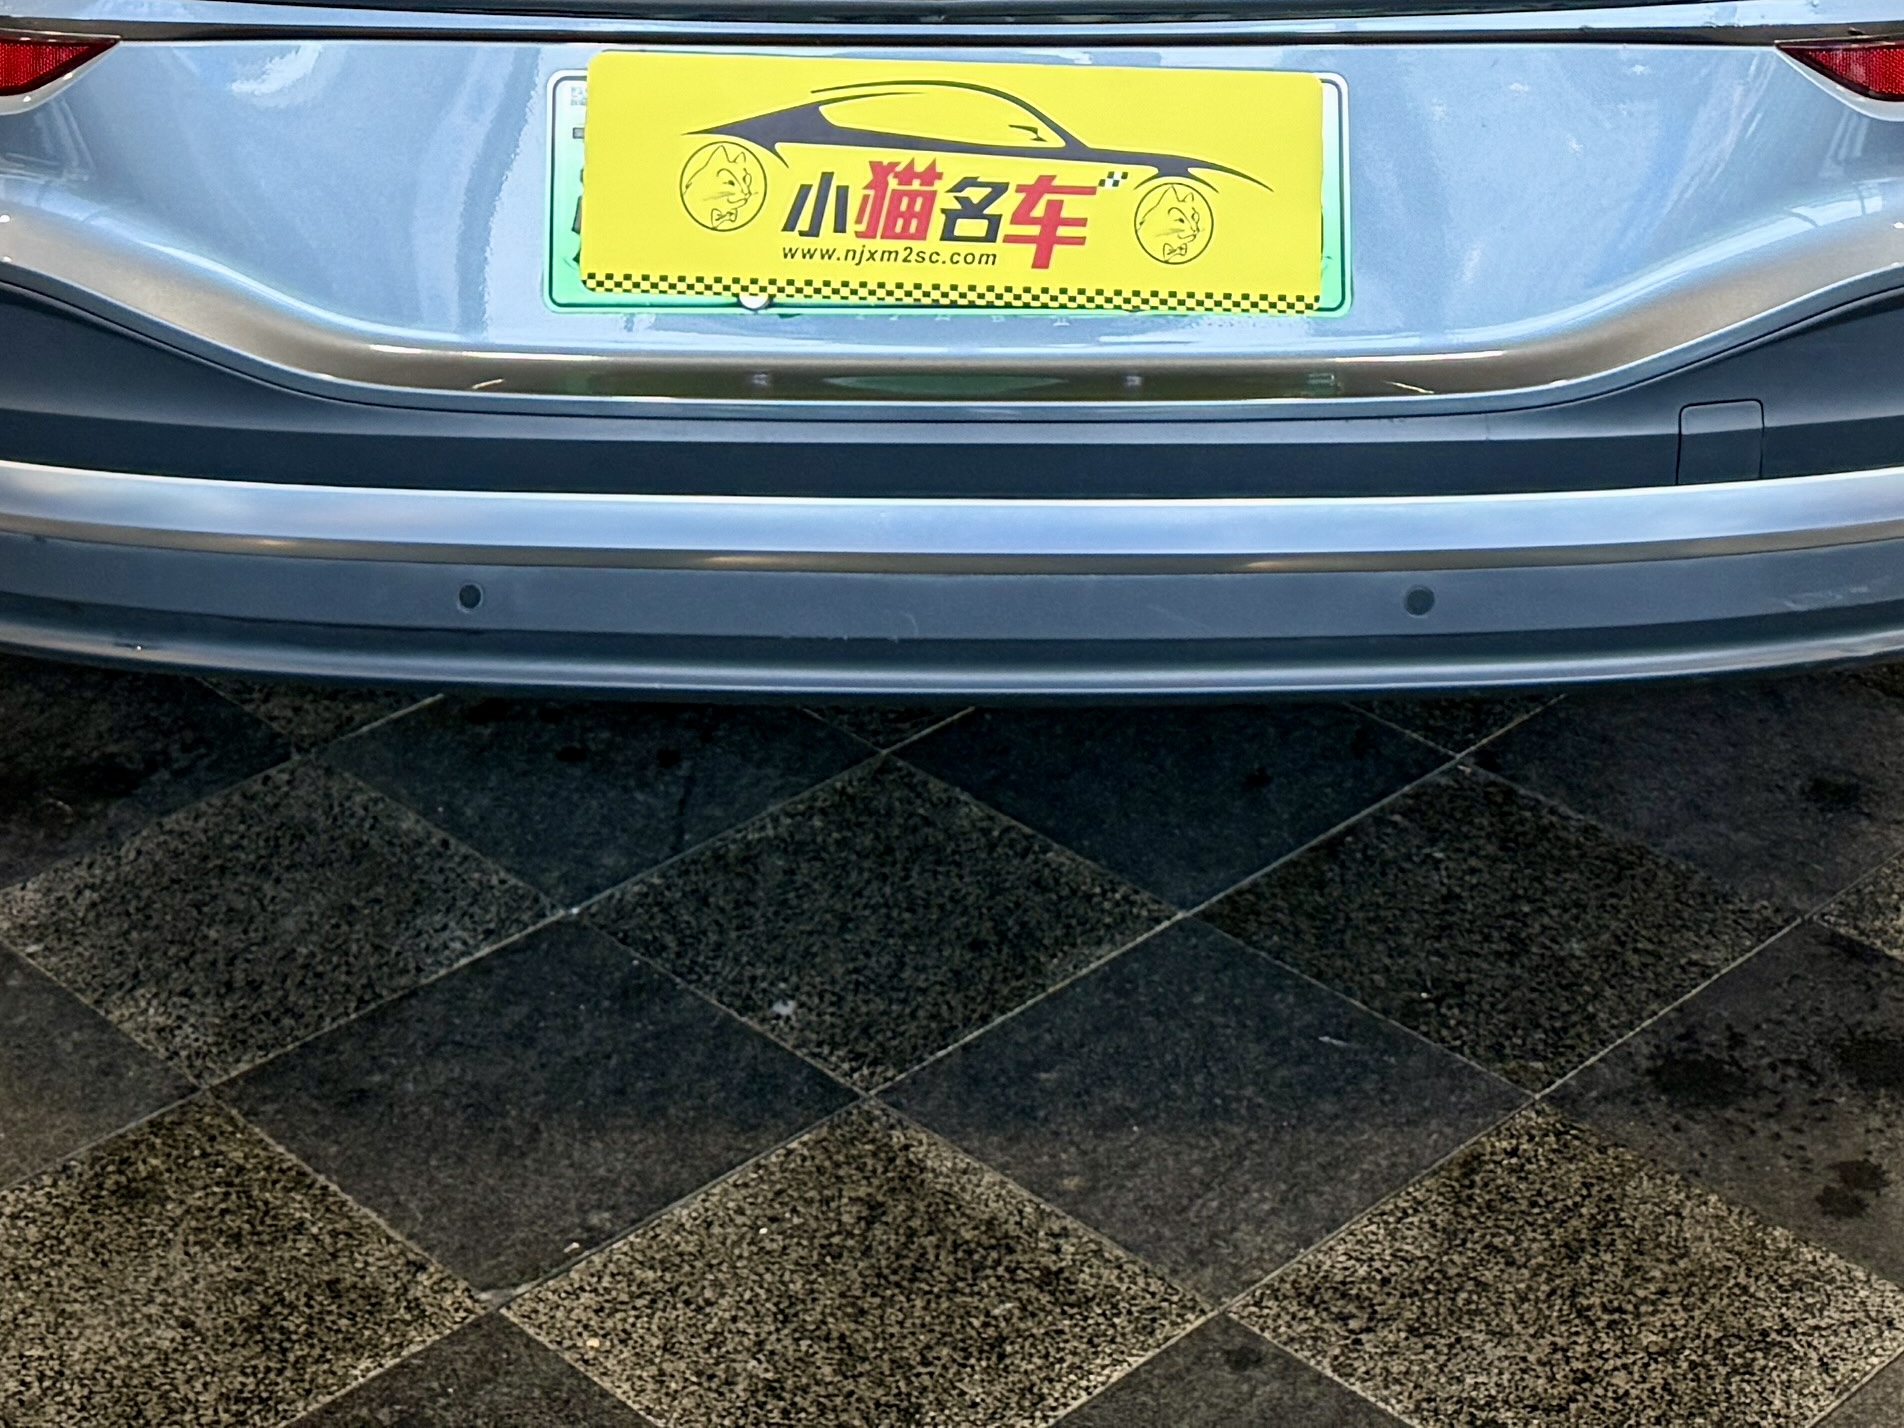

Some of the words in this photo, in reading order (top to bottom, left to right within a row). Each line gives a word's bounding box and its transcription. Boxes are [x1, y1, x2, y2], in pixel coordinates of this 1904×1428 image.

[781, 156, 1098, 269] 小猫名车
[782, 244, 997, 267] www.njxm2sc.com
